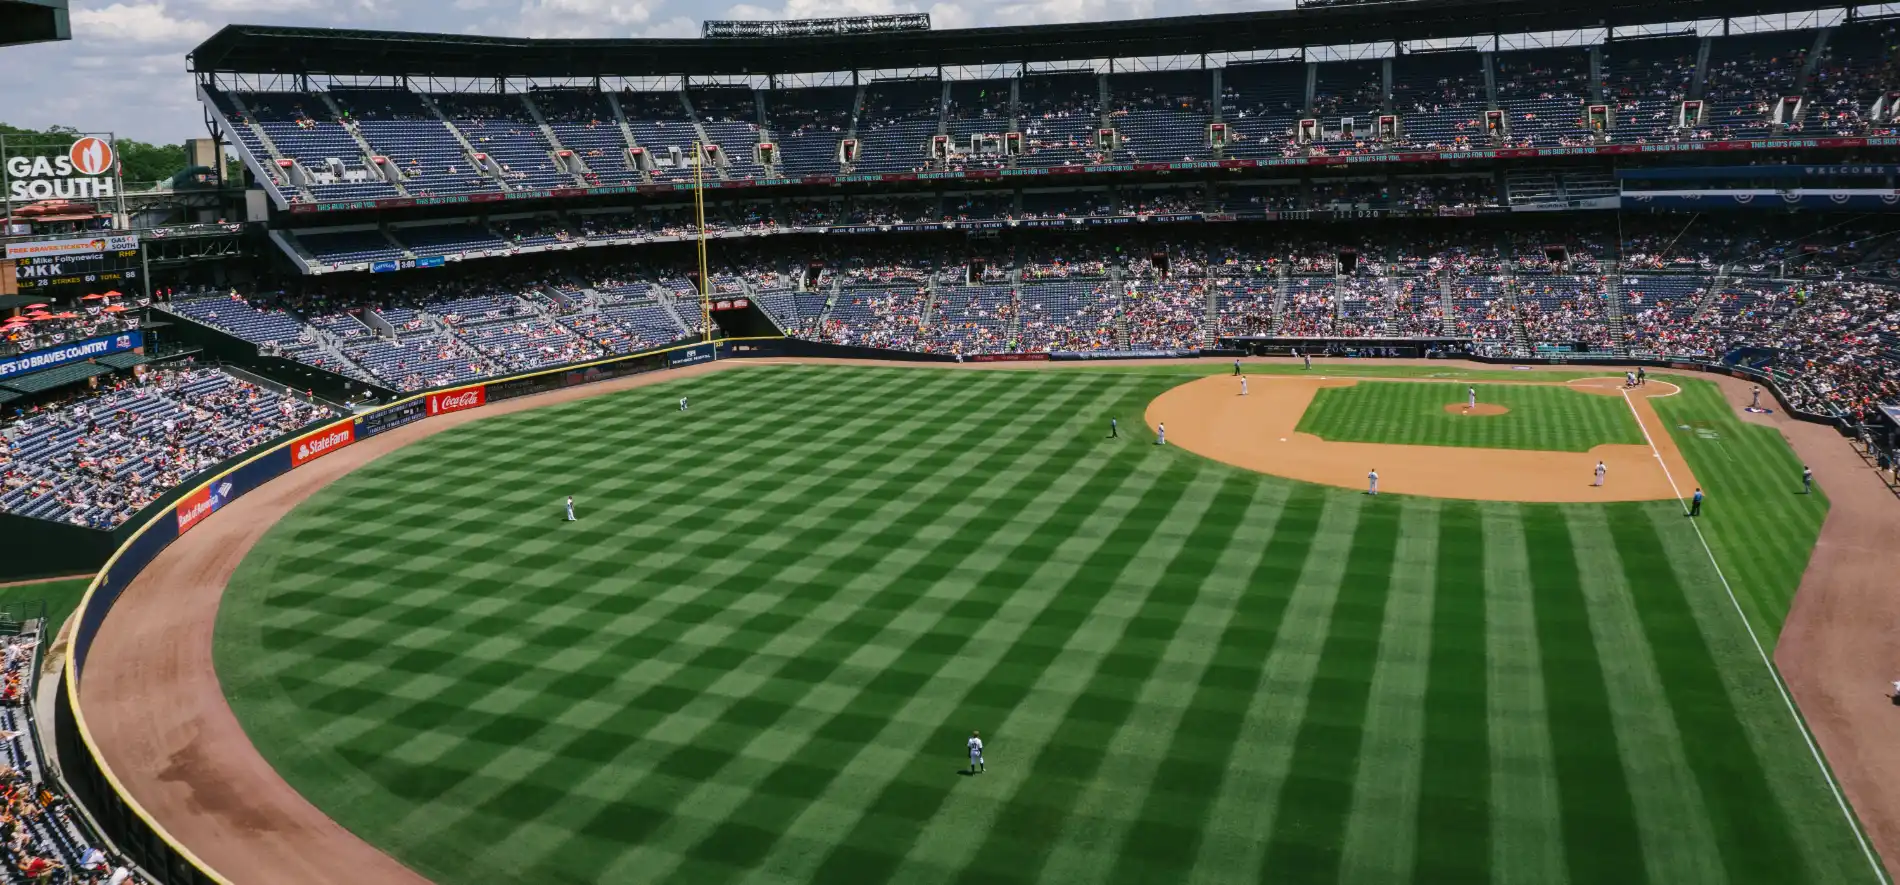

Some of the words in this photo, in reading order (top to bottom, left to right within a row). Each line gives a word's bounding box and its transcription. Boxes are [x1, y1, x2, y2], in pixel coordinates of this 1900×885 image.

[7, 156, 72, 177] GAS
[1805, 166, 1884, 174] WELCOME
[11, 177, 114, 200] SOUTH
[55, 254, 103, 263] Foltynewicz
[17, 358, 30, 370] TO
[31, 351, 66, 367] BRAVES
[67, 341, 108, 358] COUNTRY
